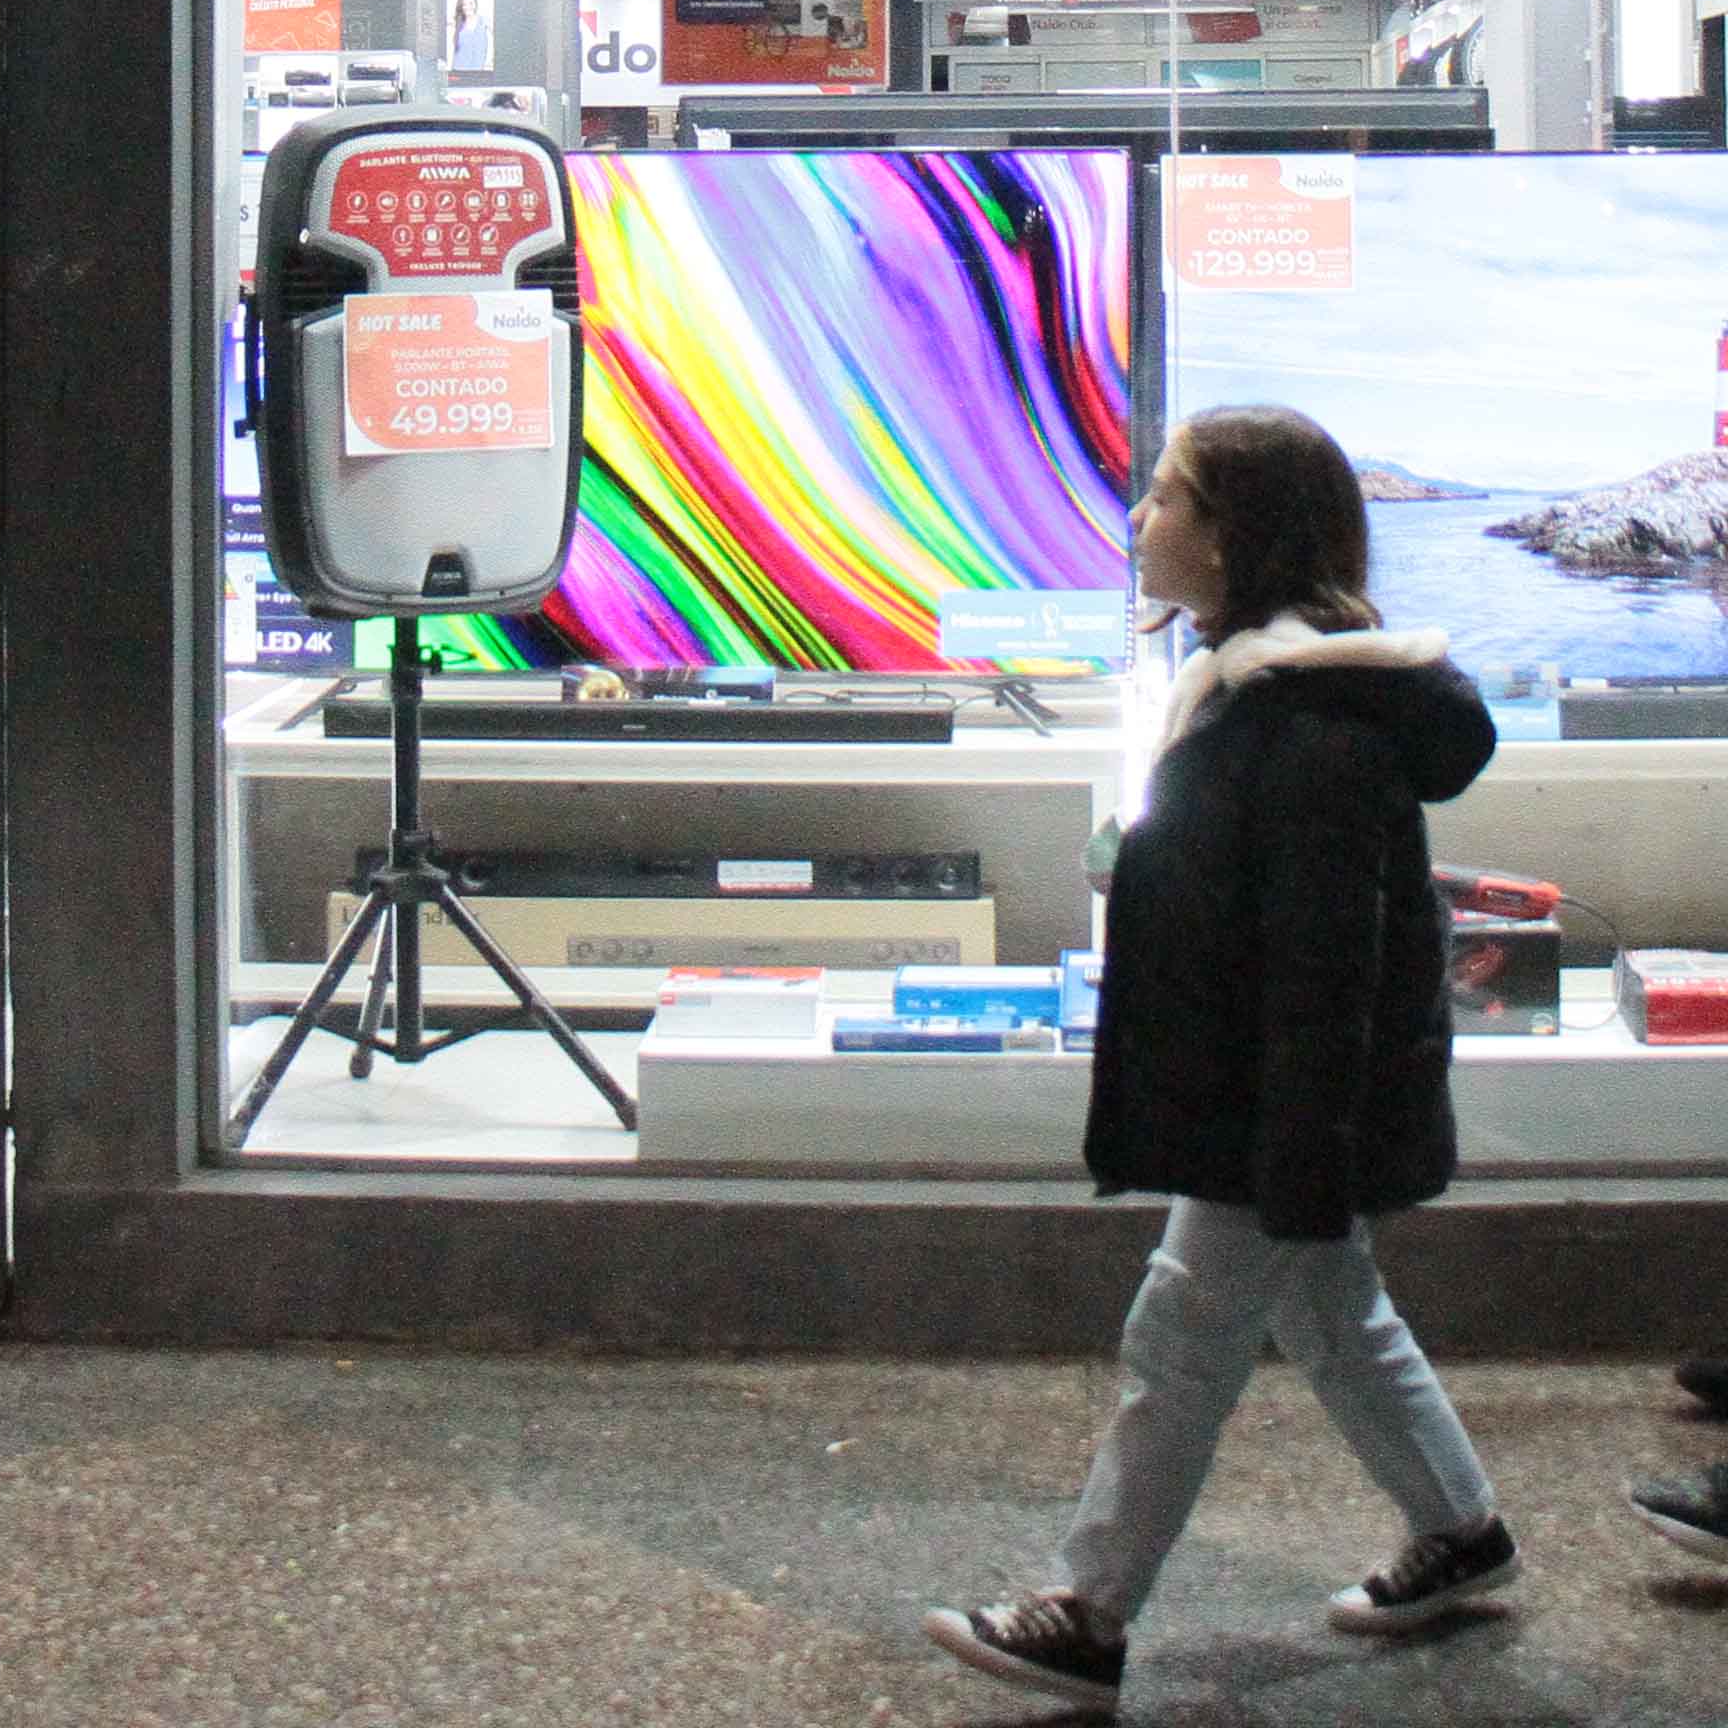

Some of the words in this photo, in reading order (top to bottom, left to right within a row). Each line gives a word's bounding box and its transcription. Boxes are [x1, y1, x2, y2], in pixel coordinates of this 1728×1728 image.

[418, 167, 471, 180] AIWA
[1295, 172, 1344, 189] Naldo
[1207, 228, 1310, 245] CONTADO
[1191, 249, 1316, 278] 129.999
[358, 315, 394, 333] HOT
[398, 313, 443, 332] SALE
[492, 312, 542, 329] Naldo
[395, 376, 508, 398] CONTADO
[389, 401, 514, 436] 49.999
[304, 631, 334, 653] 4K
